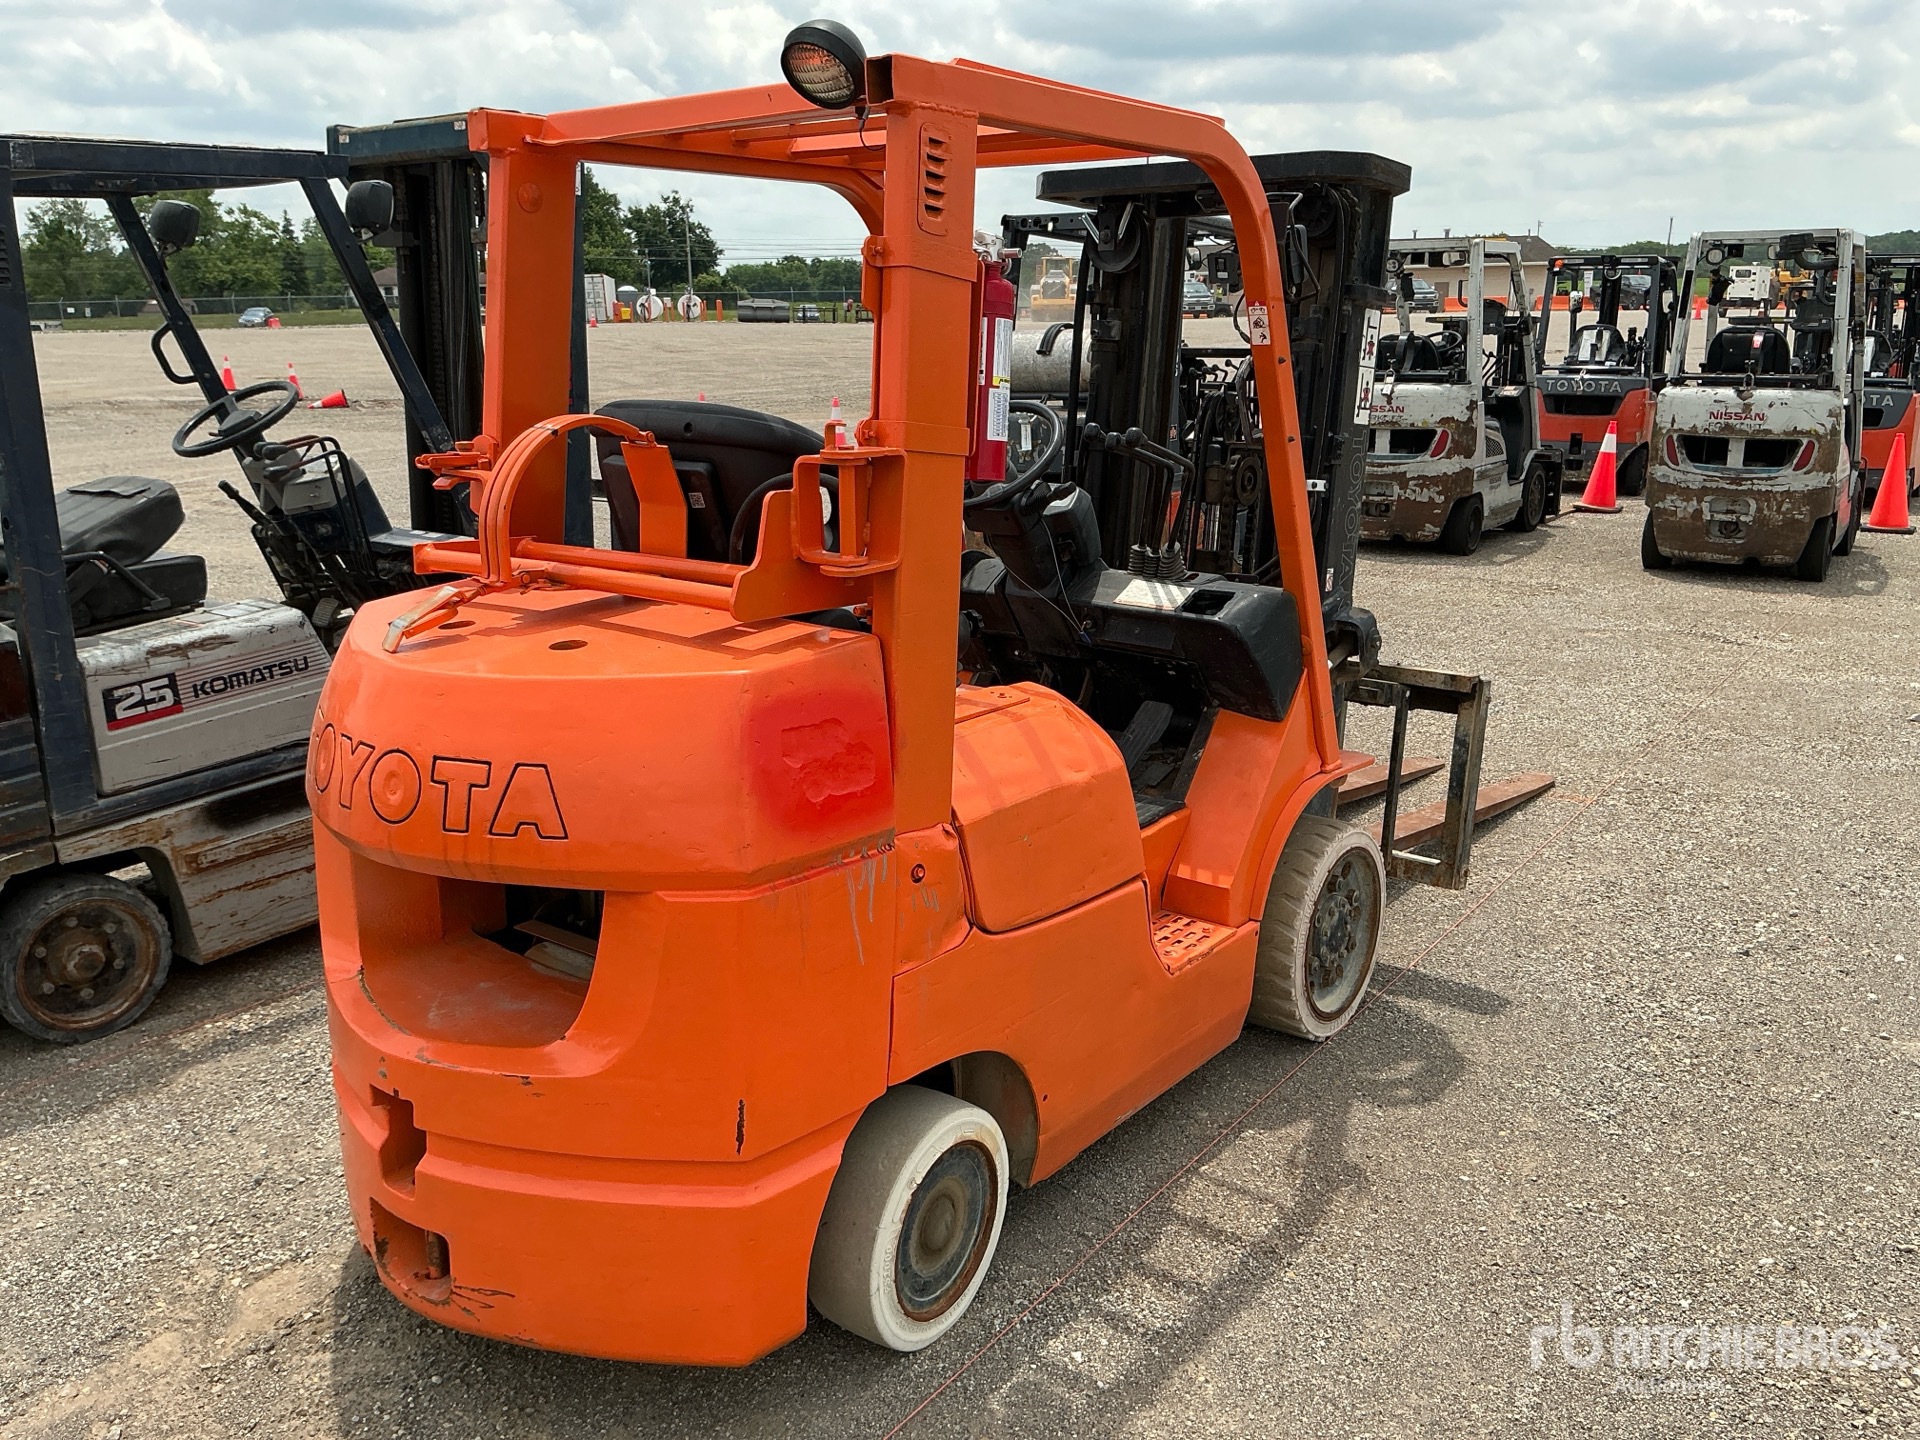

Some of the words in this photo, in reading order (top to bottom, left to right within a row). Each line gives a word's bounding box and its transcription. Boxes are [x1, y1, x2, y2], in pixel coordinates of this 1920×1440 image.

[1546, 380, 1621, 393] TOYOTA
[1370, 405, 1405, 413] SSAN
[1709, 411, 1766, 422] NISSAN
[1339, 430, 1367, 585] TOYOTA
[113, 676, 175, 720] 25
[192, 656, 310, 698] KOMATSU
[313, 722, 569, 840] OYOTA
